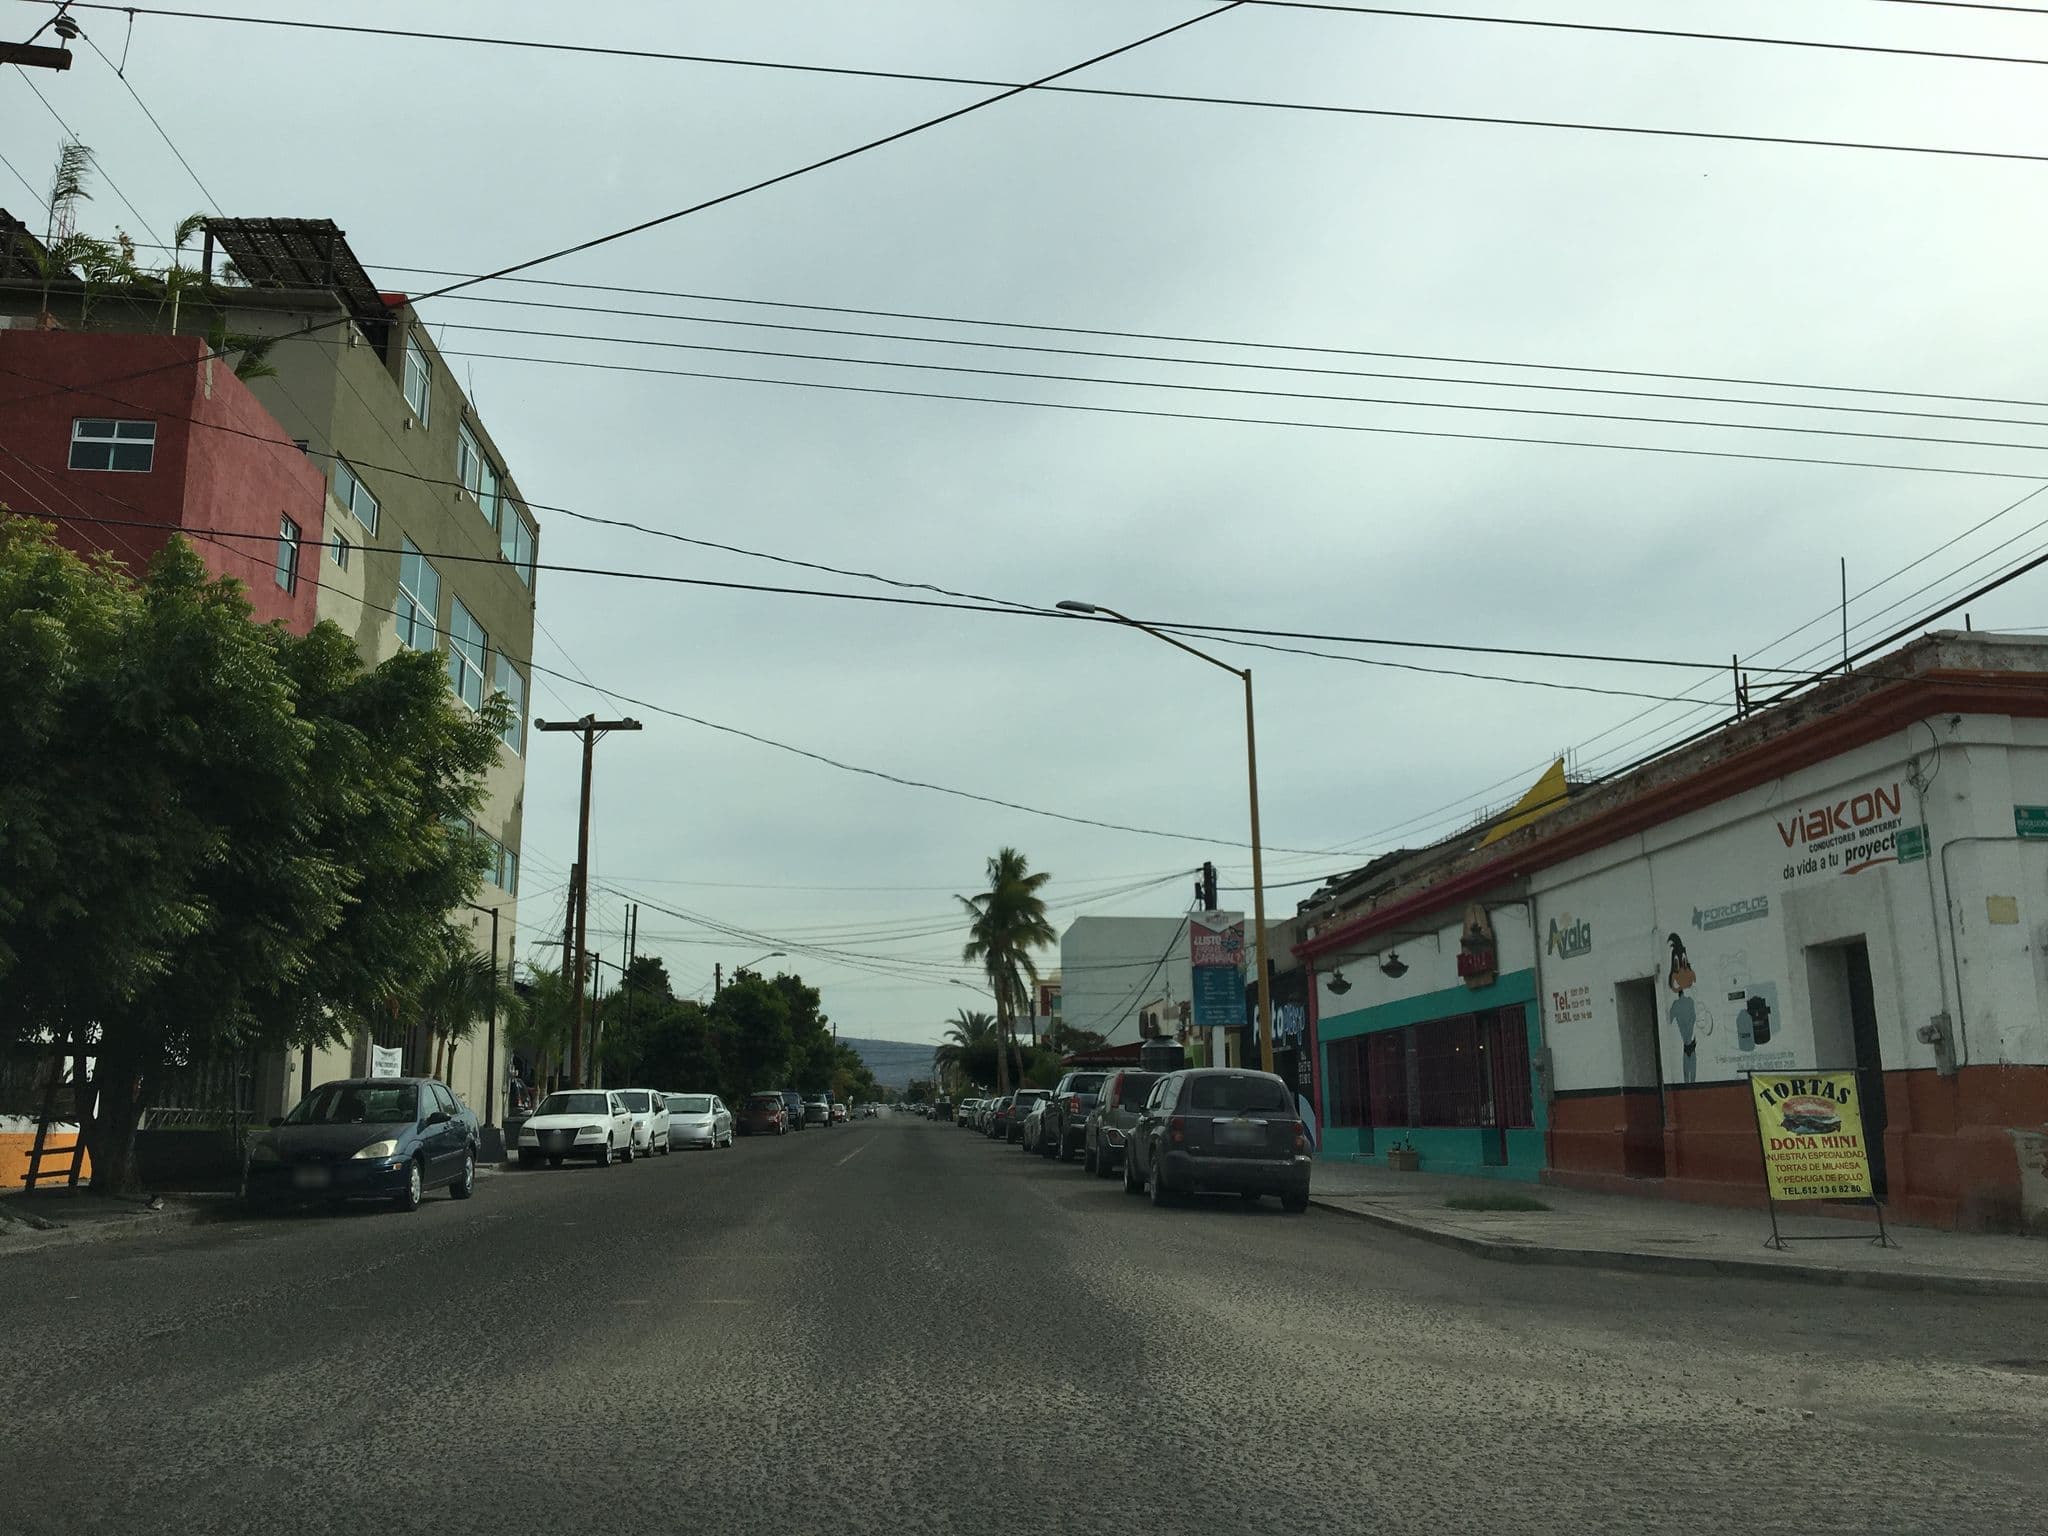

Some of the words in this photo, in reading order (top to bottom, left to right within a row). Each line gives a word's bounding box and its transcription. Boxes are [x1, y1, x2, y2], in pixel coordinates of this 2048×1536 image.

[1809, 831, 1856, 853] CONDUCTORES
[1859, 817, 1902, 838] MONTERREY
[1783, 864, 1795, 880] da
[1797, 857, 1817, 876] vida
[1820, 857, 1826, 870] a
[1829, 852, 1839, 866] tu
[1845, 832, 1897, 866] proyect
[1760, 1079, 1851, 1106] TORTAS
[1821, 1135, 1858, 1149] MINI
[1767, 1151, 1807, 1161] NUESTRA
[1808, 1150, 1865, 1160] ESPECIALIDAD
[1775, 1164, 1807, 1172] TORTAS
[1809, 1163, 1821, 1171] DE
[1822, 1161, 1861, 1171] MILANESA
[1776, 1176, 1783, 1184] Y
[1784, 1174, 1824, 1184] PECHUGA
[1825, 1174, 1837, 1182] DE
[1838, 1173, 1864, 1182] POLLO
